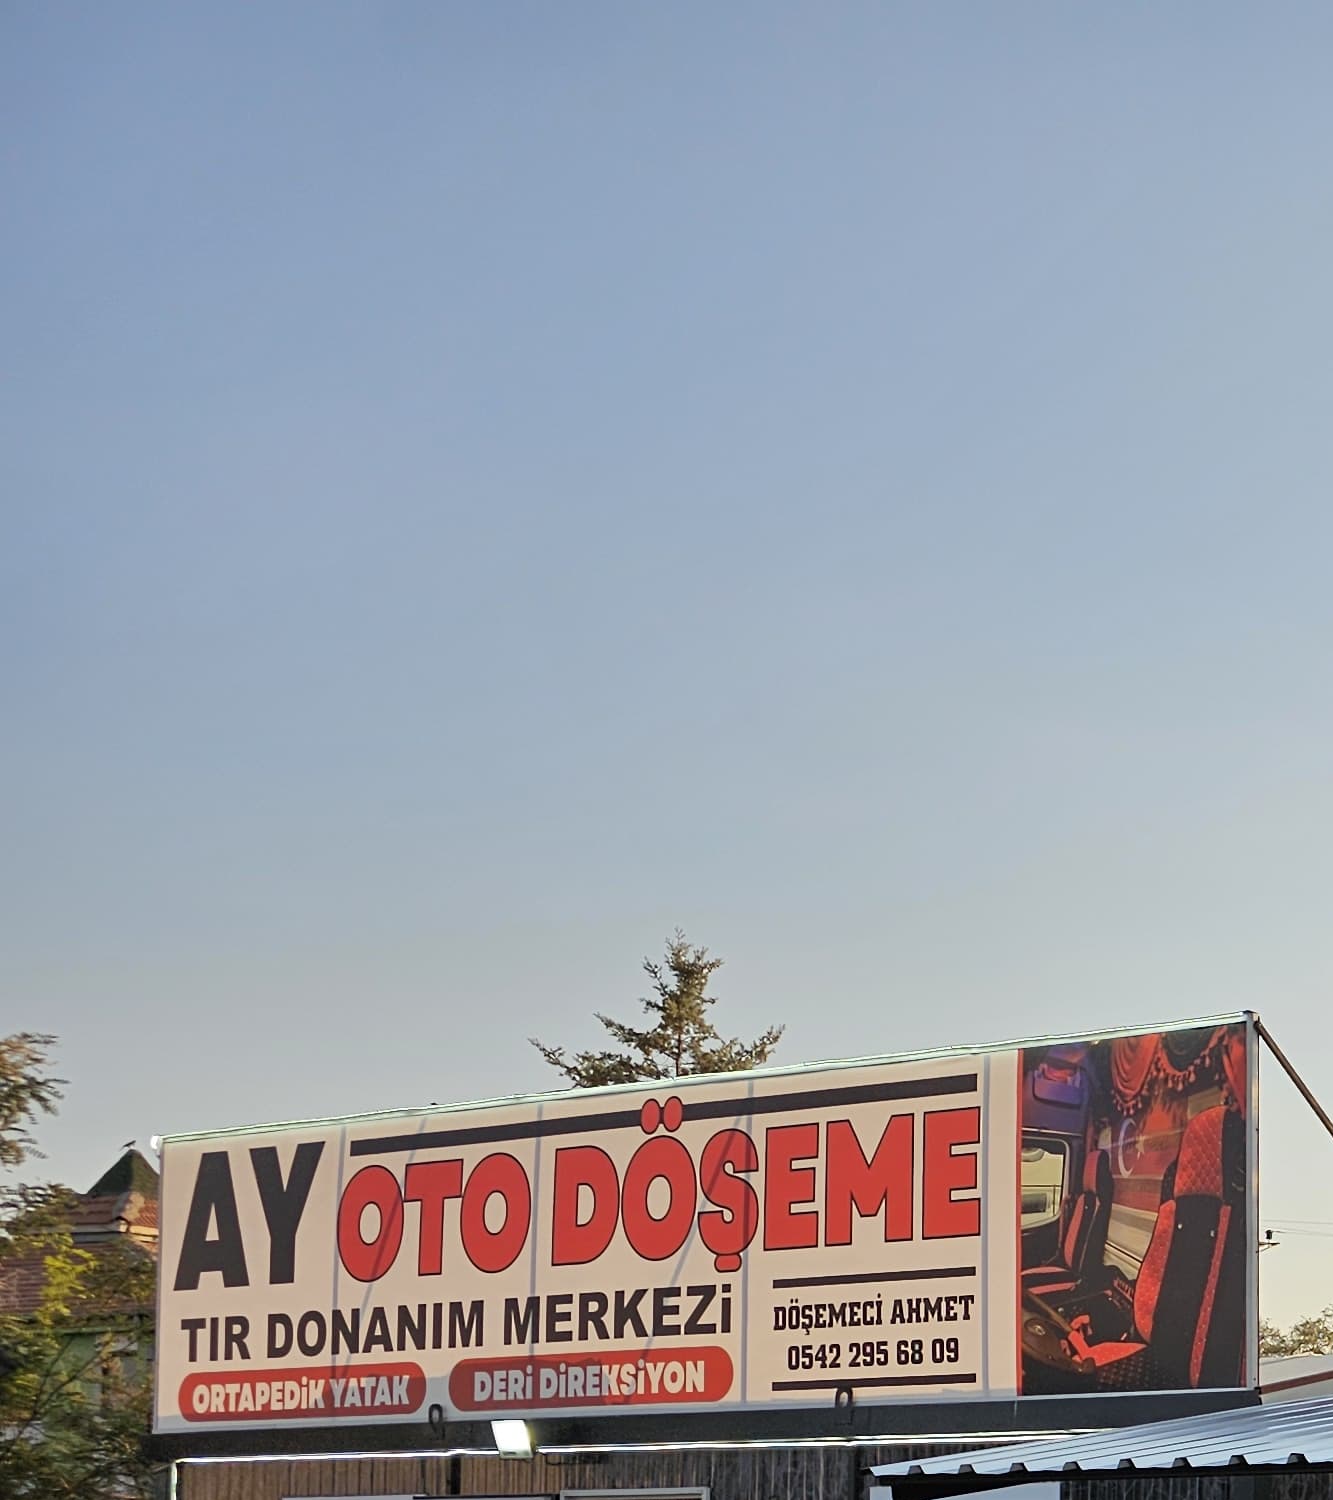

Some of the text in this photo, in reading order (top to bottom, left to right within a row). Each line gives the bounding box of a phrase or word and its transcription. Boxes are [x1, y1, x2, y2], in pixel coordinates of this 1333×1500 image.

[174, 1096, 981, 1291] AY OTO DÖŞEME
[181, 1315, 251, 1363] TIR
[267, 1299, 485, 1360] DONANIM
[773, 1293, 975, 1336] DÖŞEMECİ AHMET
[787, 1337, 960, 1371] 0542 295 68 09
[329, 1375, 409, 1408] YATAK
